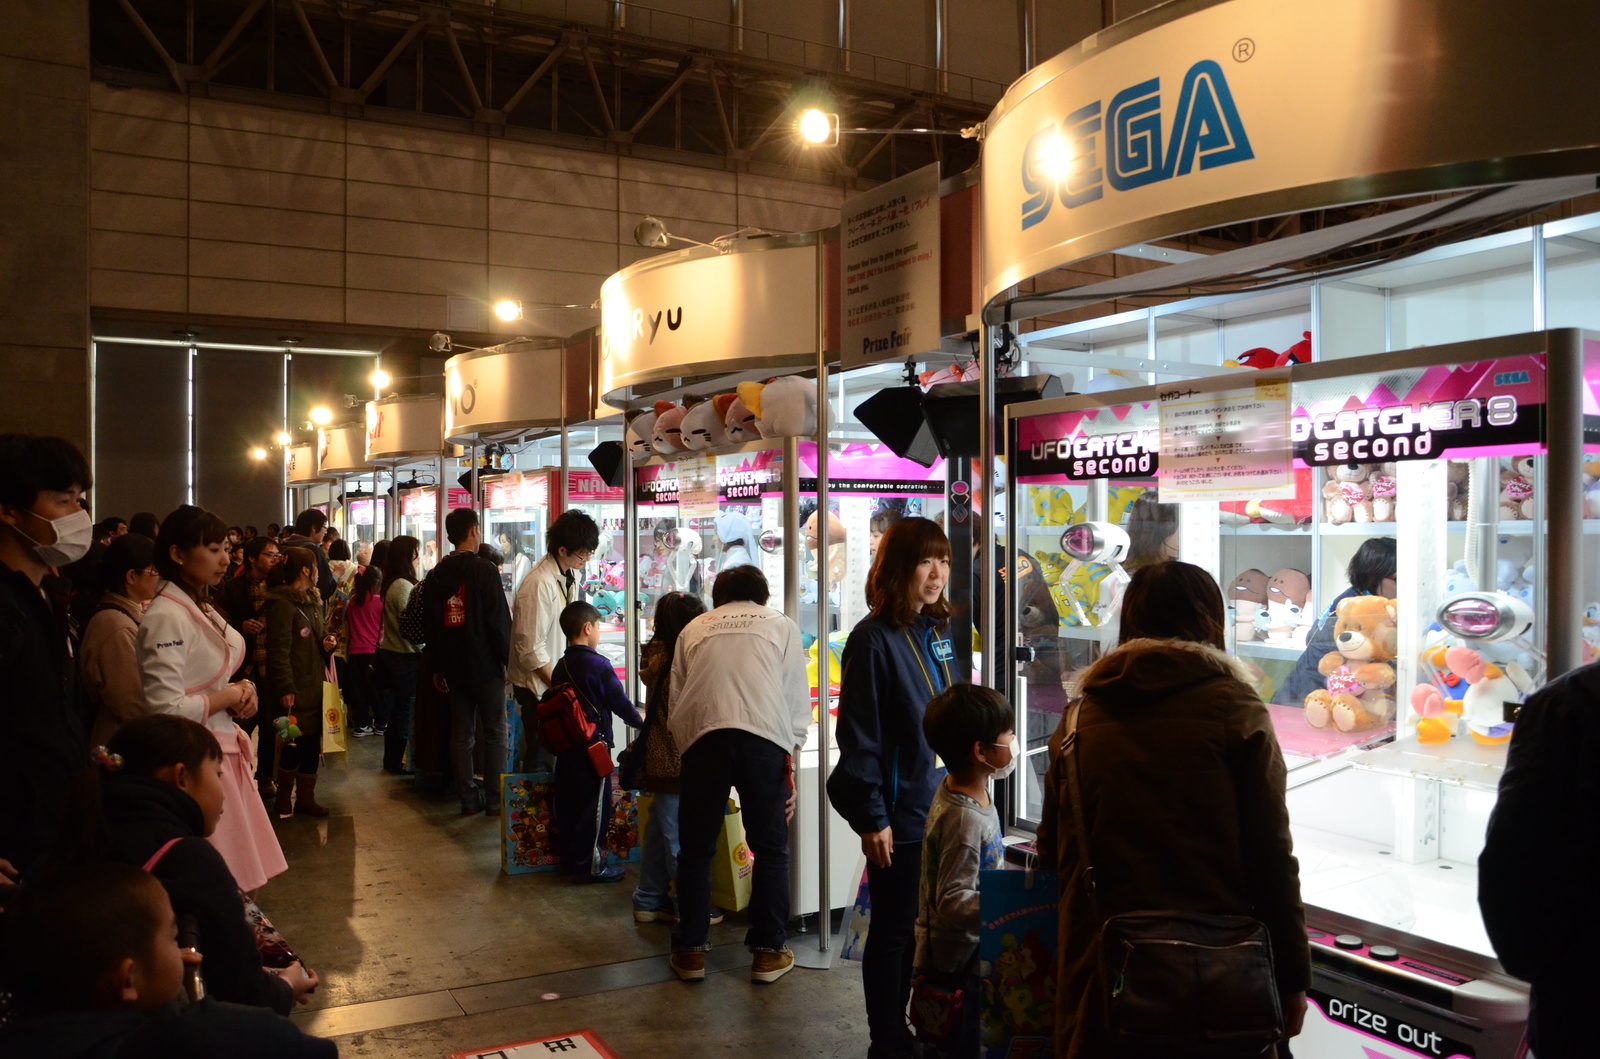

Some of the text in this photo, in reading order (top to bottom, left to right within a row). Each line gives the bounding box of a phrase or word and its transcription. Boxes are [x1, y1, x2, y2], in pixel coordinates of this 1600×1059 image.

[1021, 59, 1255, 231] SEGA
[848, 285, 859, 296] Thank
[864, 326, 912, 354] Prize Fair
[1494, 370, 1530, 386] SEGA
[1160, 389, 1201, 402] セガコーナー
[1314, 398, 1481, 440] CATCHER
[1031, 437, 1071, 460] UFO
[1073, 429, 1160, 458] CATCHE
[1314, 432, 1432, 461] second
[1073, 454, 1150, 476] second
[727, 484, 759, 497] second
[1329, 998, 1442, 1054] prize out
